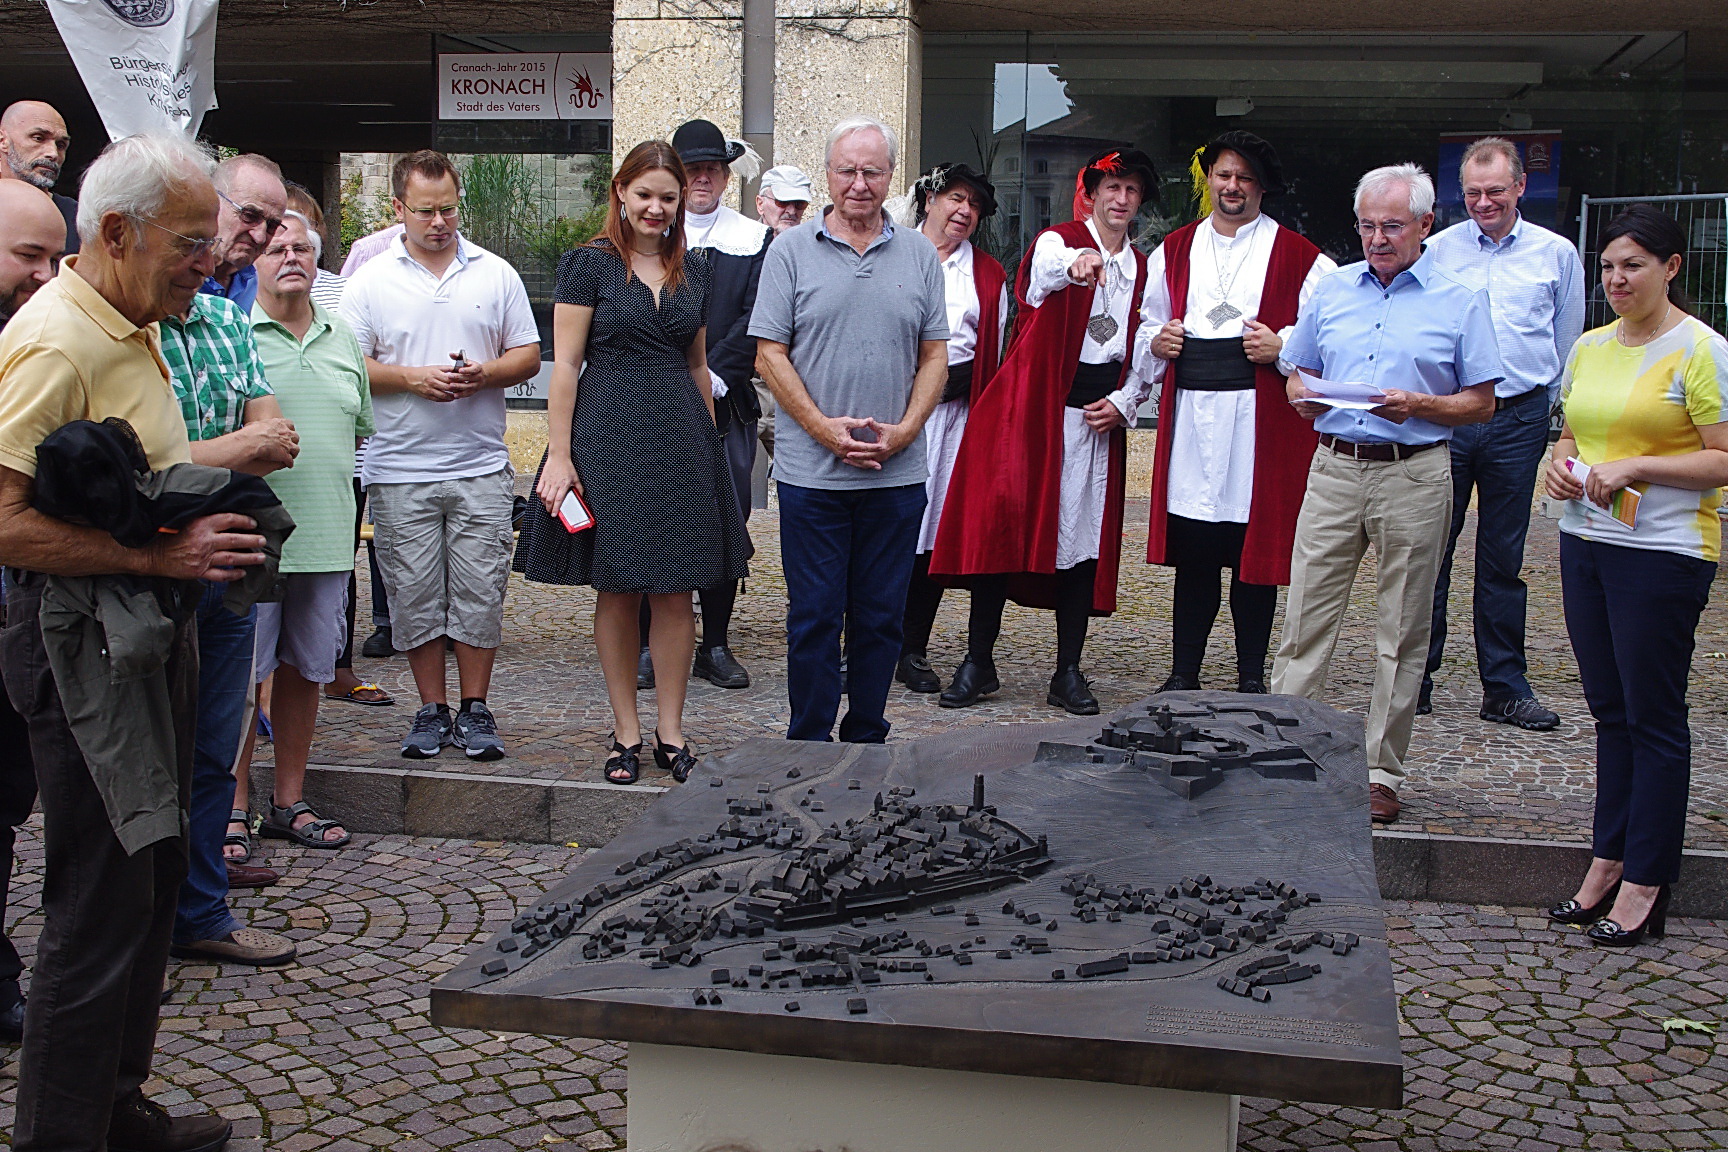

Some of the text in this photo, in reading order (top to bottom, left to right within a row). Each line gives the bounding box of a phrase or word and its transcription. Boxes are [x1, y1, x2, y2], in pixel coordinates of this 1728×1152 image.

[451, 62, 546, 73] Cranach-Jahr 2015
[451, 78, 546, 95] KRONACH
[456, 102, 541, 112] Stadt des Vaters
